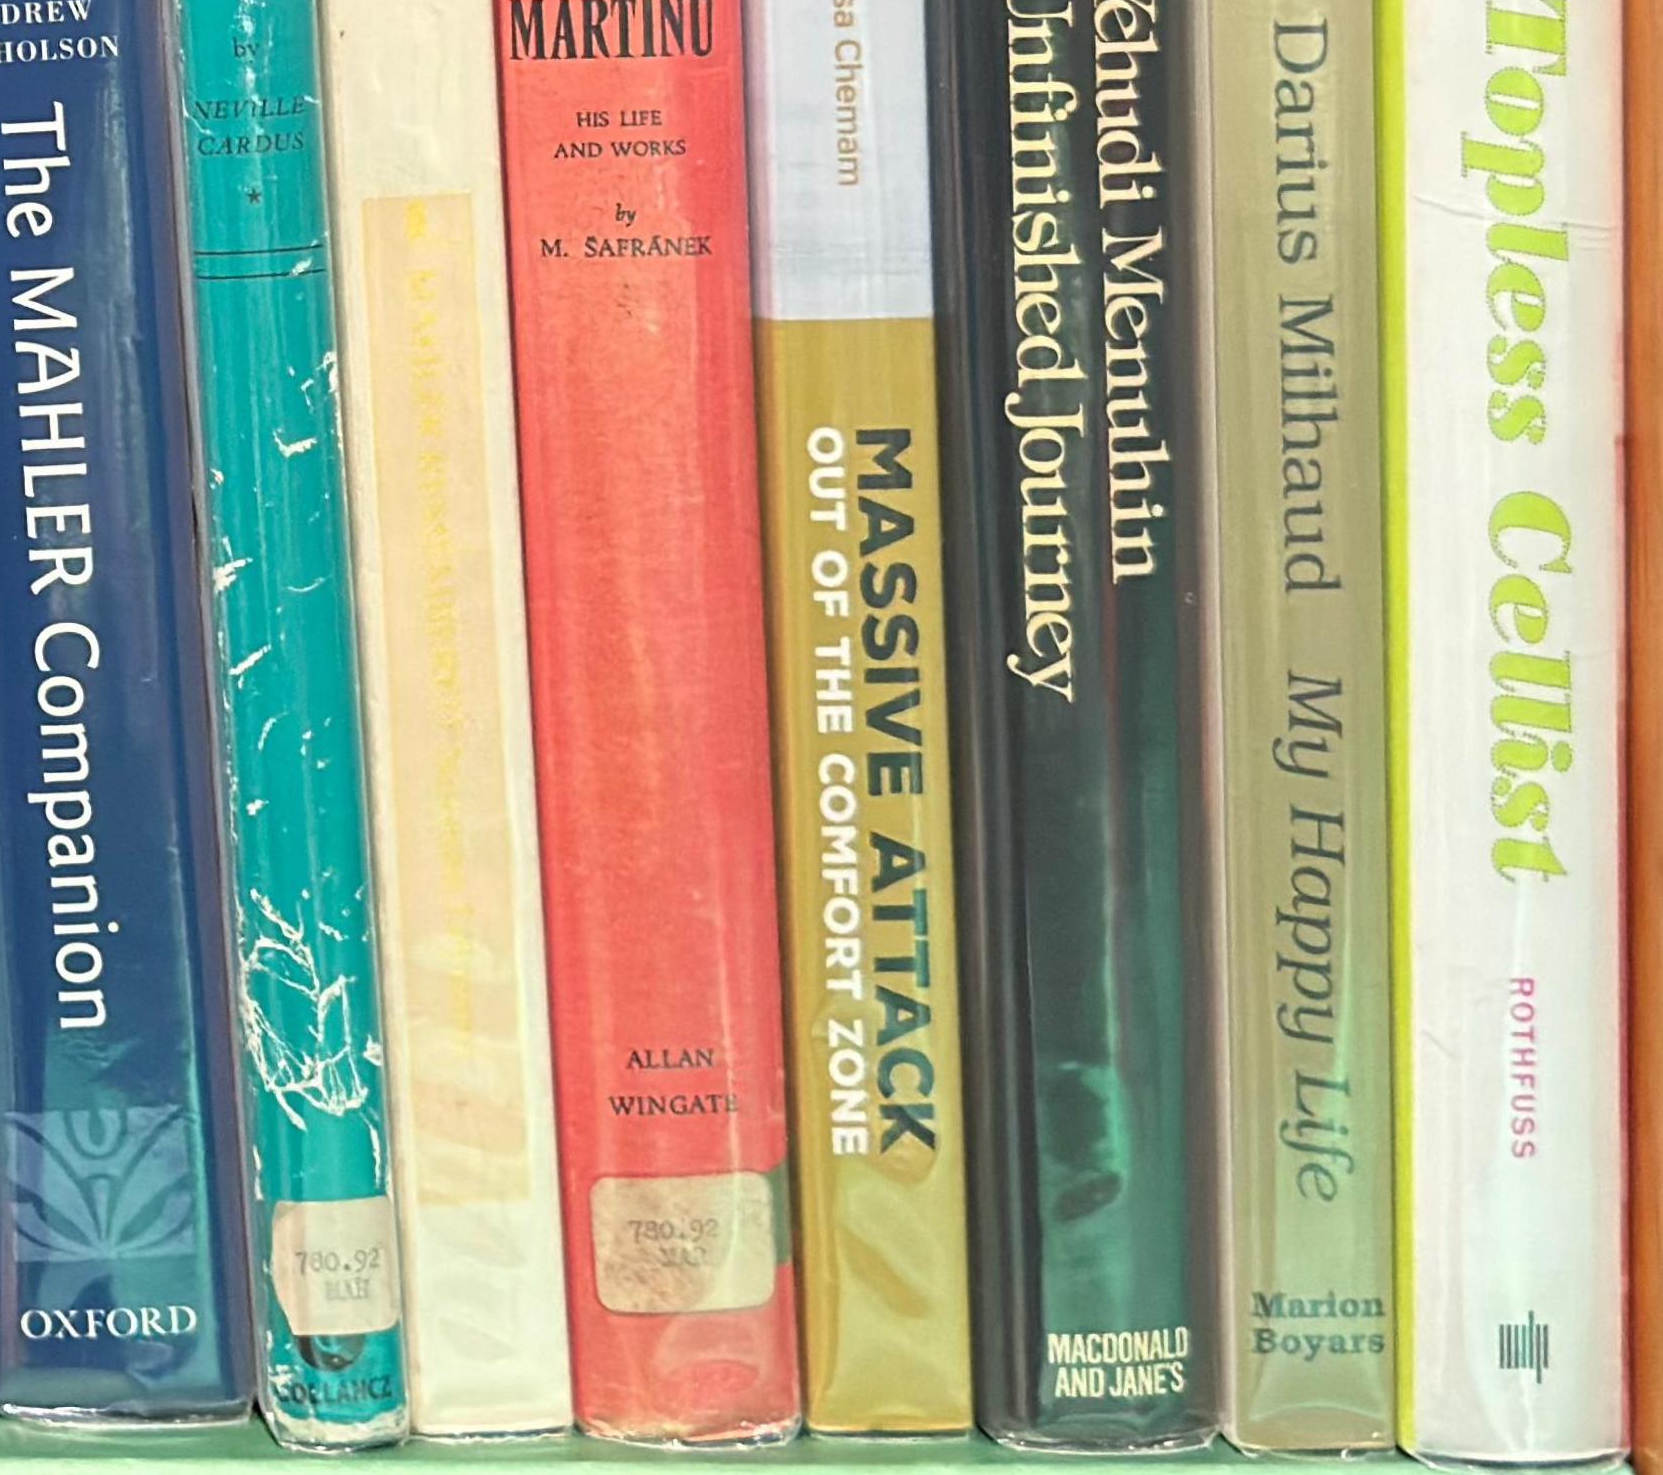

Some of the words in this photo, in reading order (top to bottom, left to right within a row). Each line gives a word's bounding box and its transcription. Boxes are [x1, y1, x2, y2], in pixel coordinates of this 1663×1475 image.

[233, 37, 260, 60] by
[194, 97, 306, 120] NEVILLE
[198, 132, 304, 156] CARDUS
[554, 141, 602, 158] AND
[612, 140, 686, 157] WORKS
[577, 111, 609, 127] HIS
[621, 110, 662, 126] LIFE
[832, 39, 863, 187] Chemam
[1274, 18, 1335, 267] Darius
[0, 101, 71, 238] The
[615, 203, 636, 227] by
[541, 239, 569, 257] M.
[10, 266, 94, 597] MAHLER
[1097, 223, 1173, 585] Menuhin
[1278, 294, 1343, 594] Milhaud
[807, 427, 846, 531] OUT
[811, 550, 849, 618] OF
[1005, 391, 1084, 703] Journey
[856, 429, 924, 796] MASSIVE
[813, 636, 855, 734] THE
[1270, 671, 1343, 780] My
[1487, 490, 1573, 883] Cellist
[28, 620, 120, 1031] Companion
[817, 752, 866, 1002] COMFORT
[1274, 803, 1347, 1045] Happy
[868, 832, 938, 1156] ATTACK
[609, 1094, 739, 1116] WINGATE
[627, 1048, 714, 1069] ALLAN
[824, 1017, 869, 1156] ZONE
[1508, 977, 1540, 1159] ROTHFUSS
[1278, 1069, 1355, 1201] Life
[19, 1303, 197, 1341] OXFORD
[1047, 1326, 1189, 1363] MACDONALD
[1251, 1291, 1386, 1321] Marion
[1251, 1325, 1386, 1358] Boyars
[1054, 1368, 1104, 1398] AND
[1109, 1360, 1186, 1396] JANE'S
